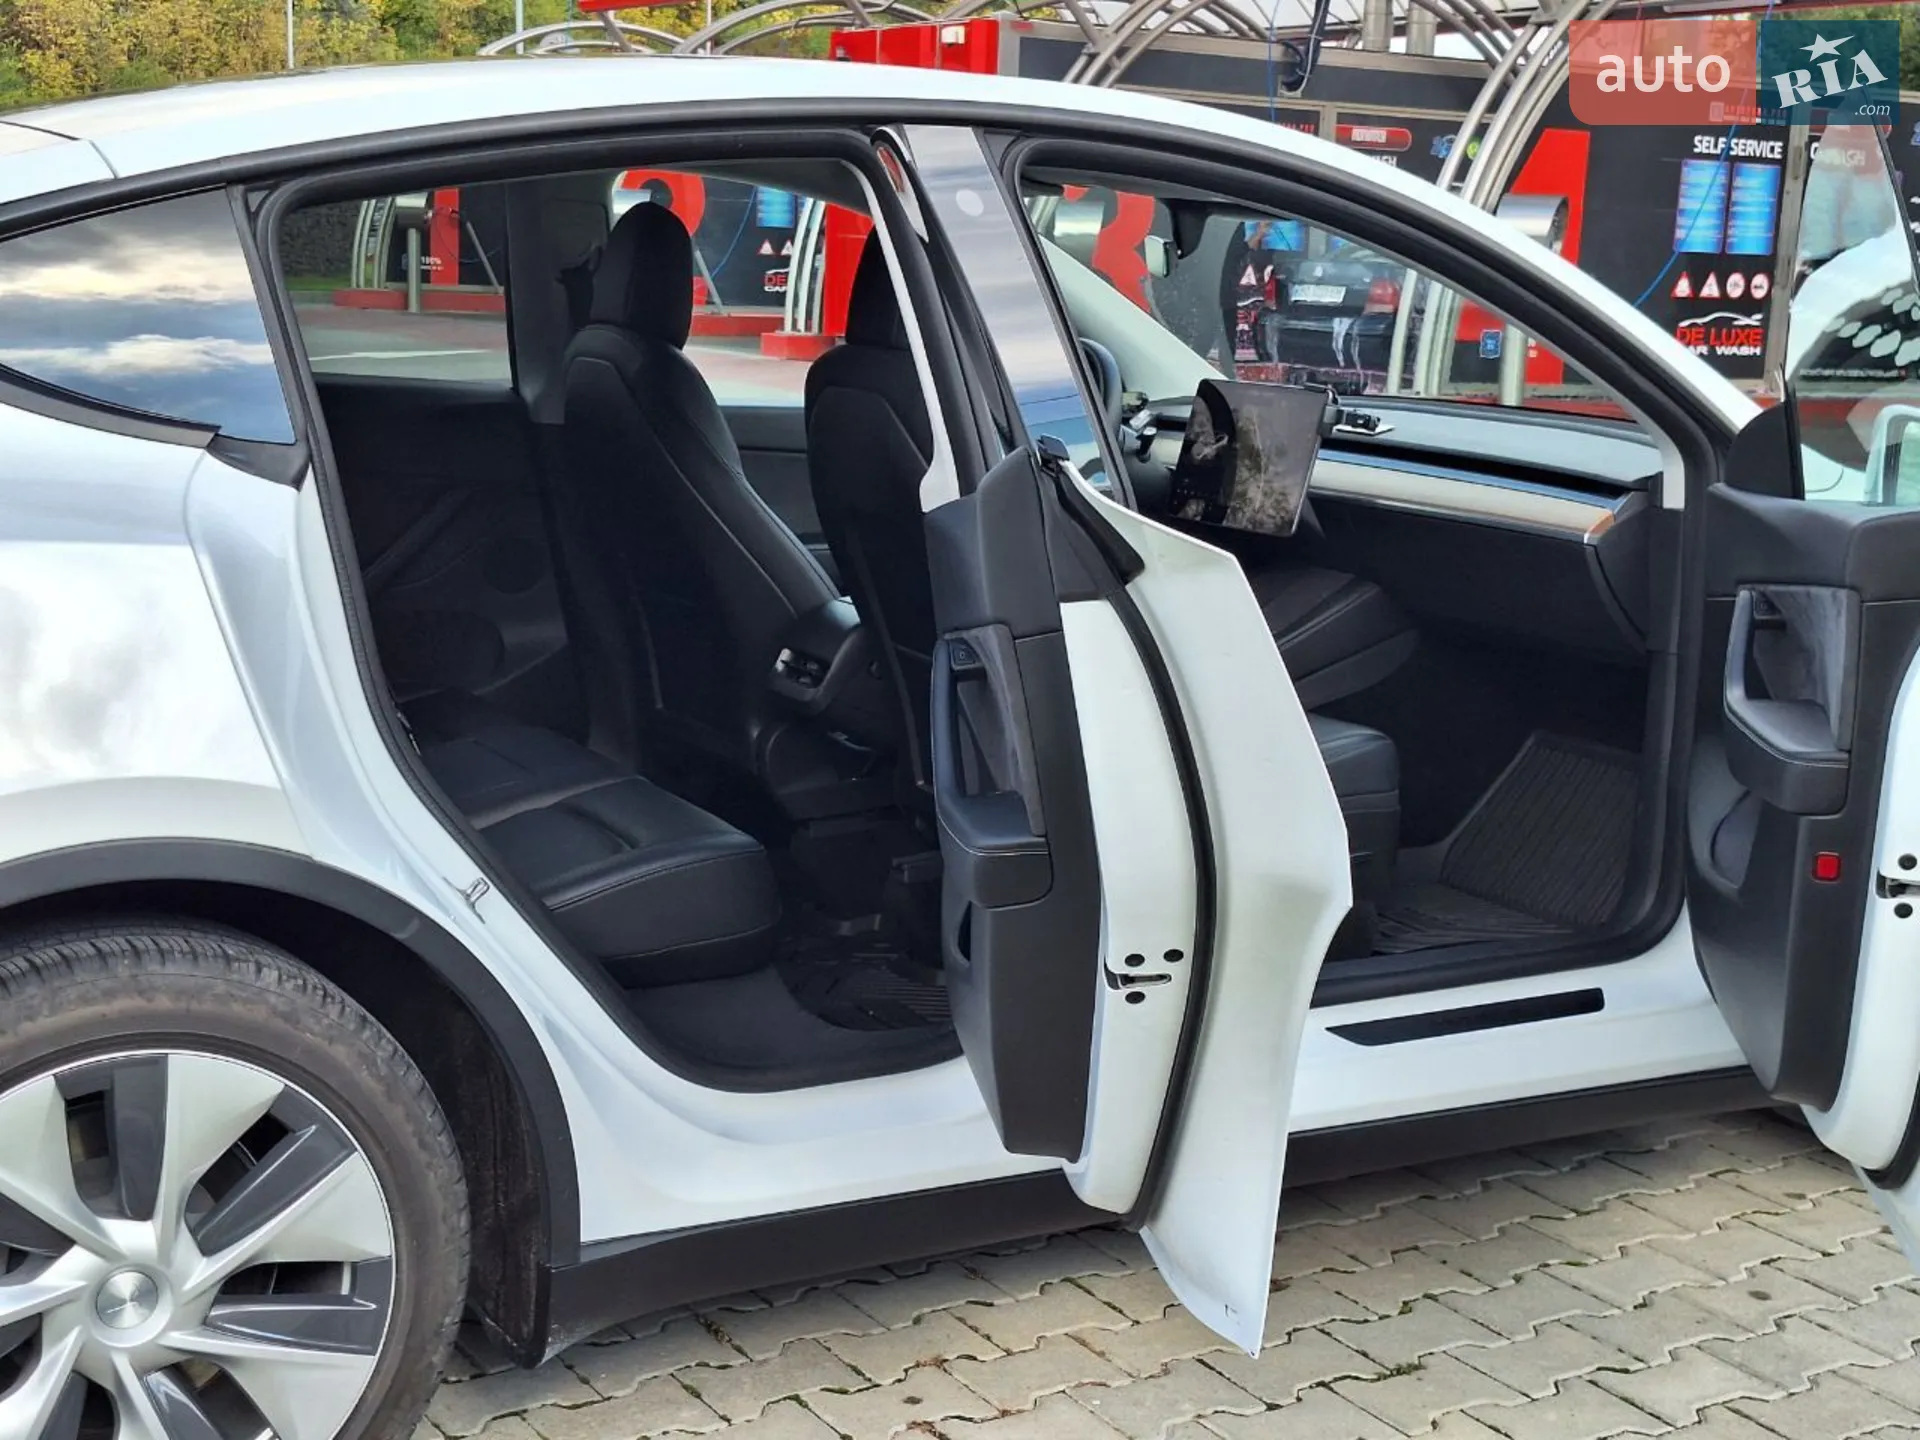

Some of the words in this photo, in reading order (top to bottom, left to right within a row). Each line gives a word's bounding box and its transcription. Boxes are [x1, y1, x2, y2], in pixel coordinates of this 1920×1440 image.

[1693, 135, 1727, 155] SELF
[1729, 137, 1784, 159] SERVICE
[1675, 327, 1705, 346] DE
[1710, 328, 1763, 347] LUXE
[1715, 346, 1761, 356] WASH
